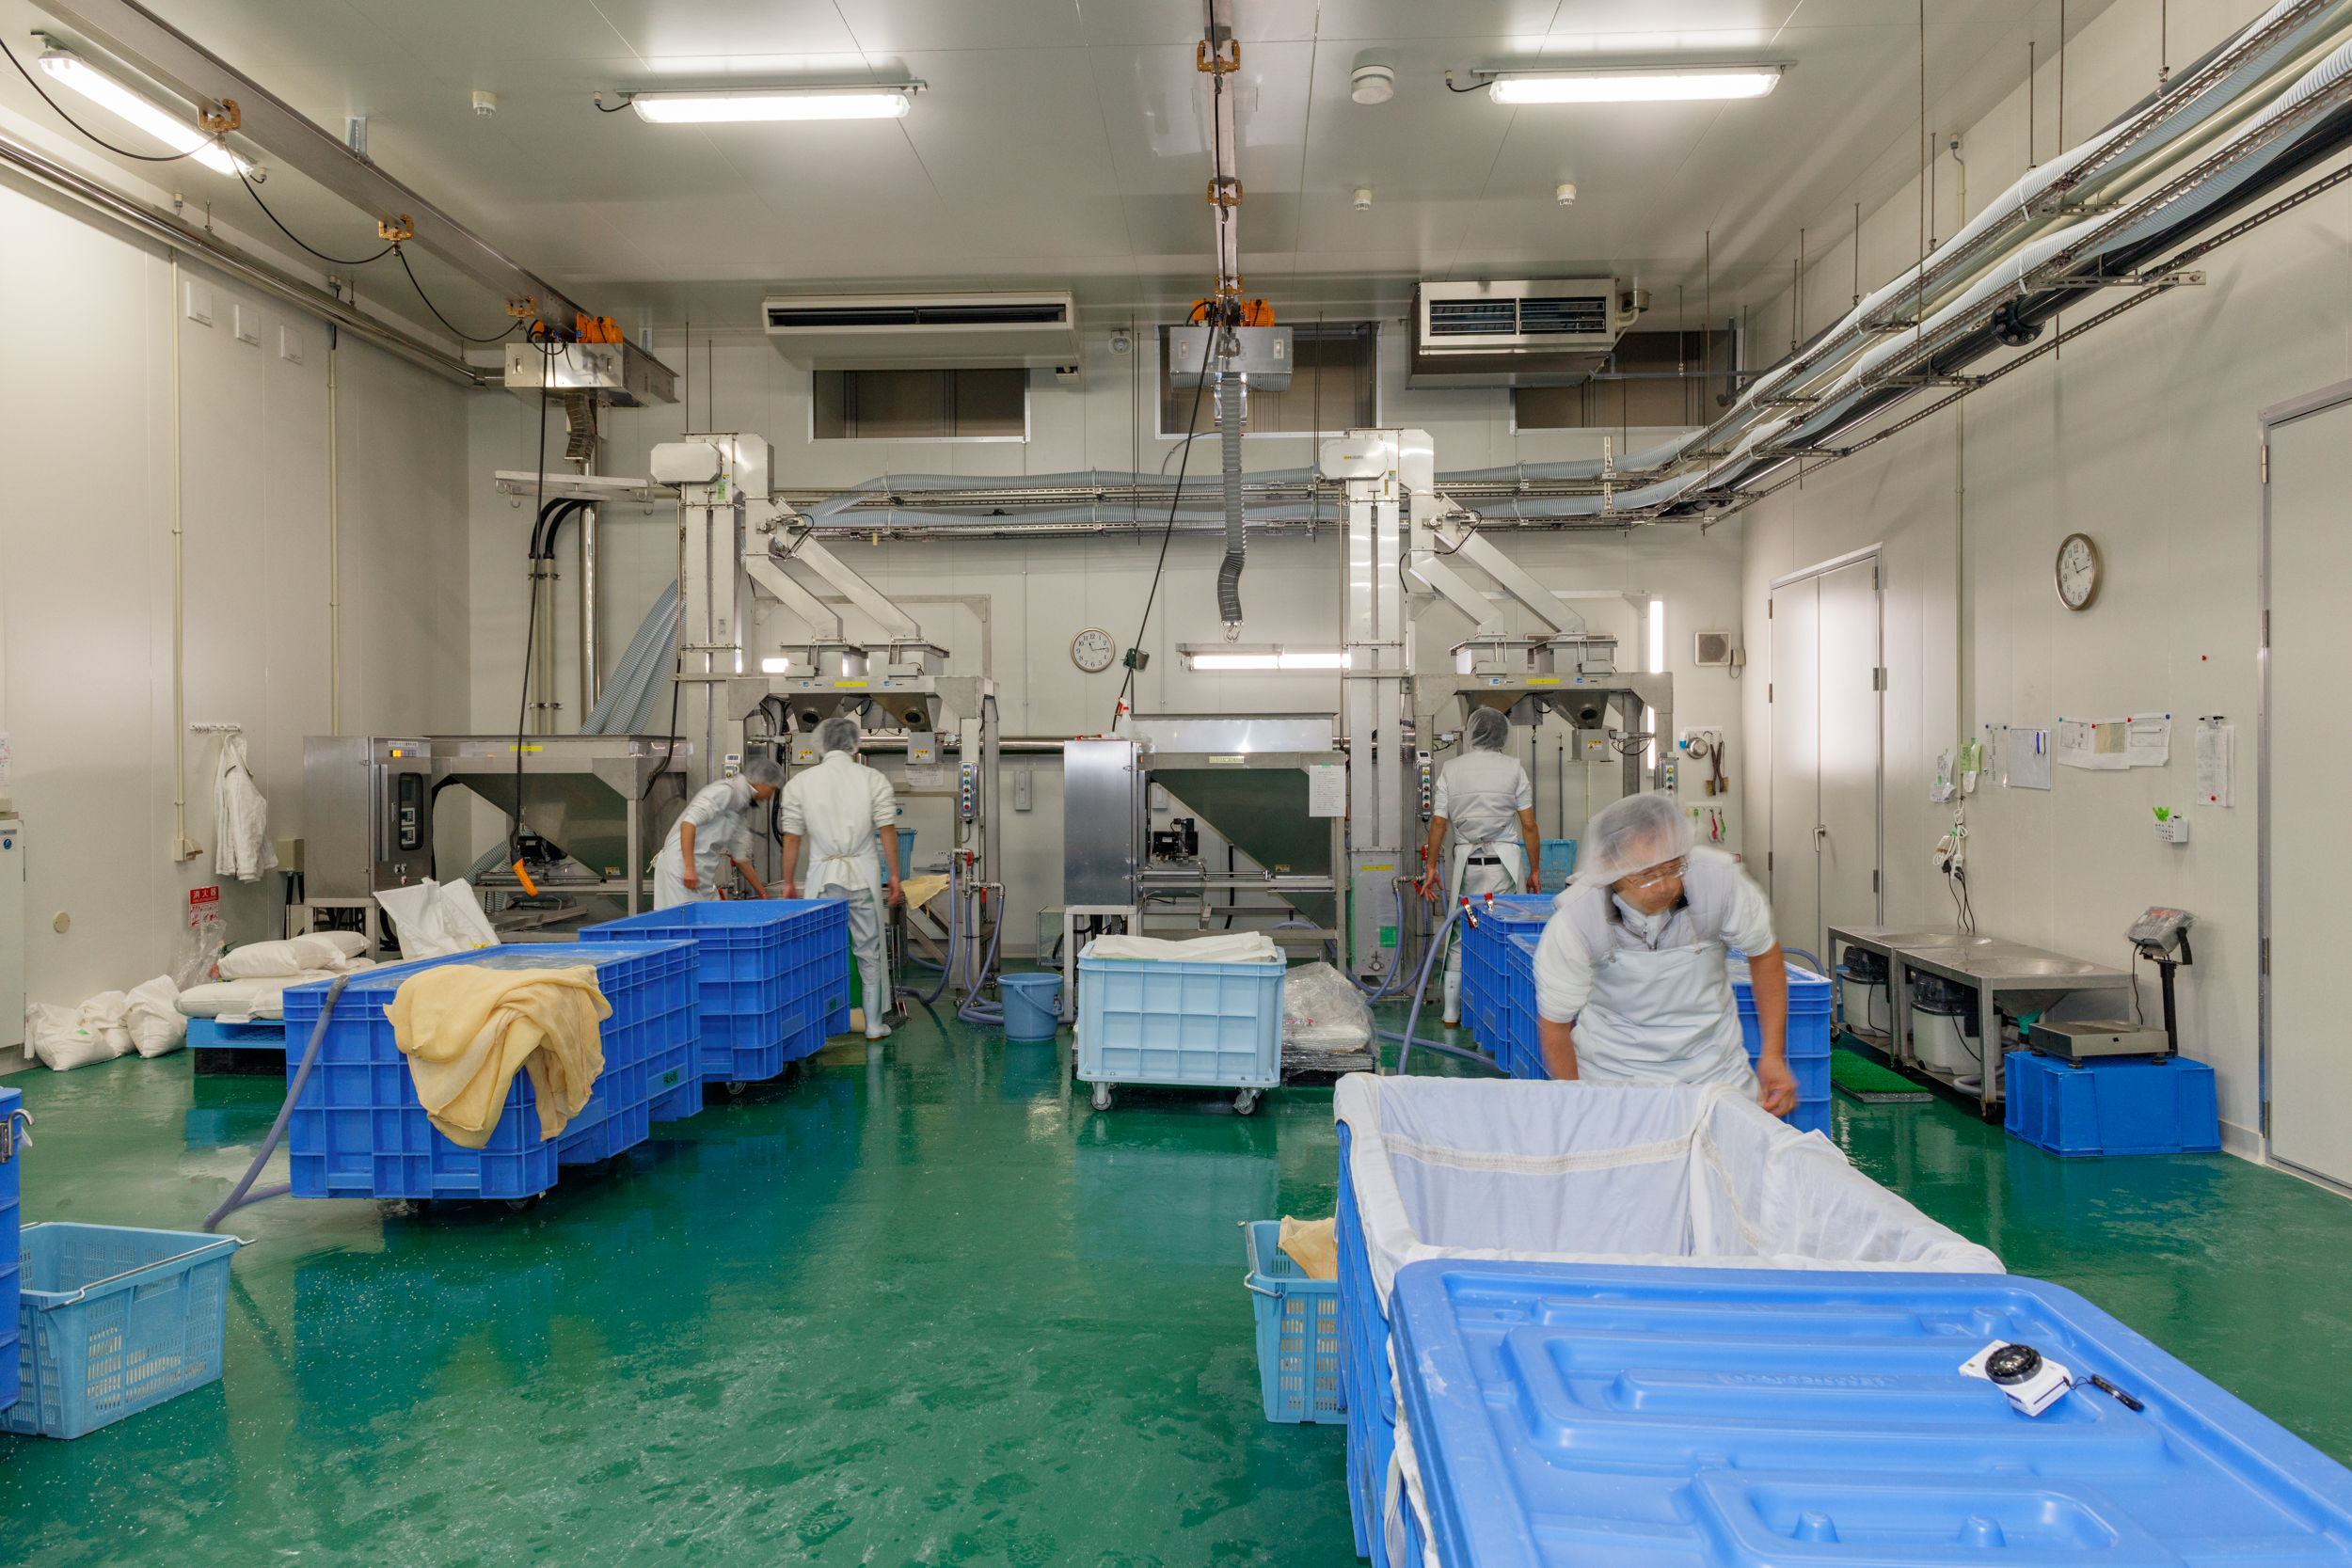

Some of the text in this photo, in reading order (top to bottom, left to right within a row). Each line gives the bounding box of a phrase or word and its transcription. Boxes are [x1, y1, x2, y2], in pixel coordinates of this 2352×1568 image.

[2074, 544, 2078, 553] 12
[2068, 549, 2073, 559] 11
[2064, 560, 2070, 569] 10
[2063, 574, 2067, 582] 9
[2067, 585, 2071, 594] 8
[2072, 592, 2075, 600] 7
[2078, 593, 2082, 601] 6
[193, 888, 216, 898] 消火器
